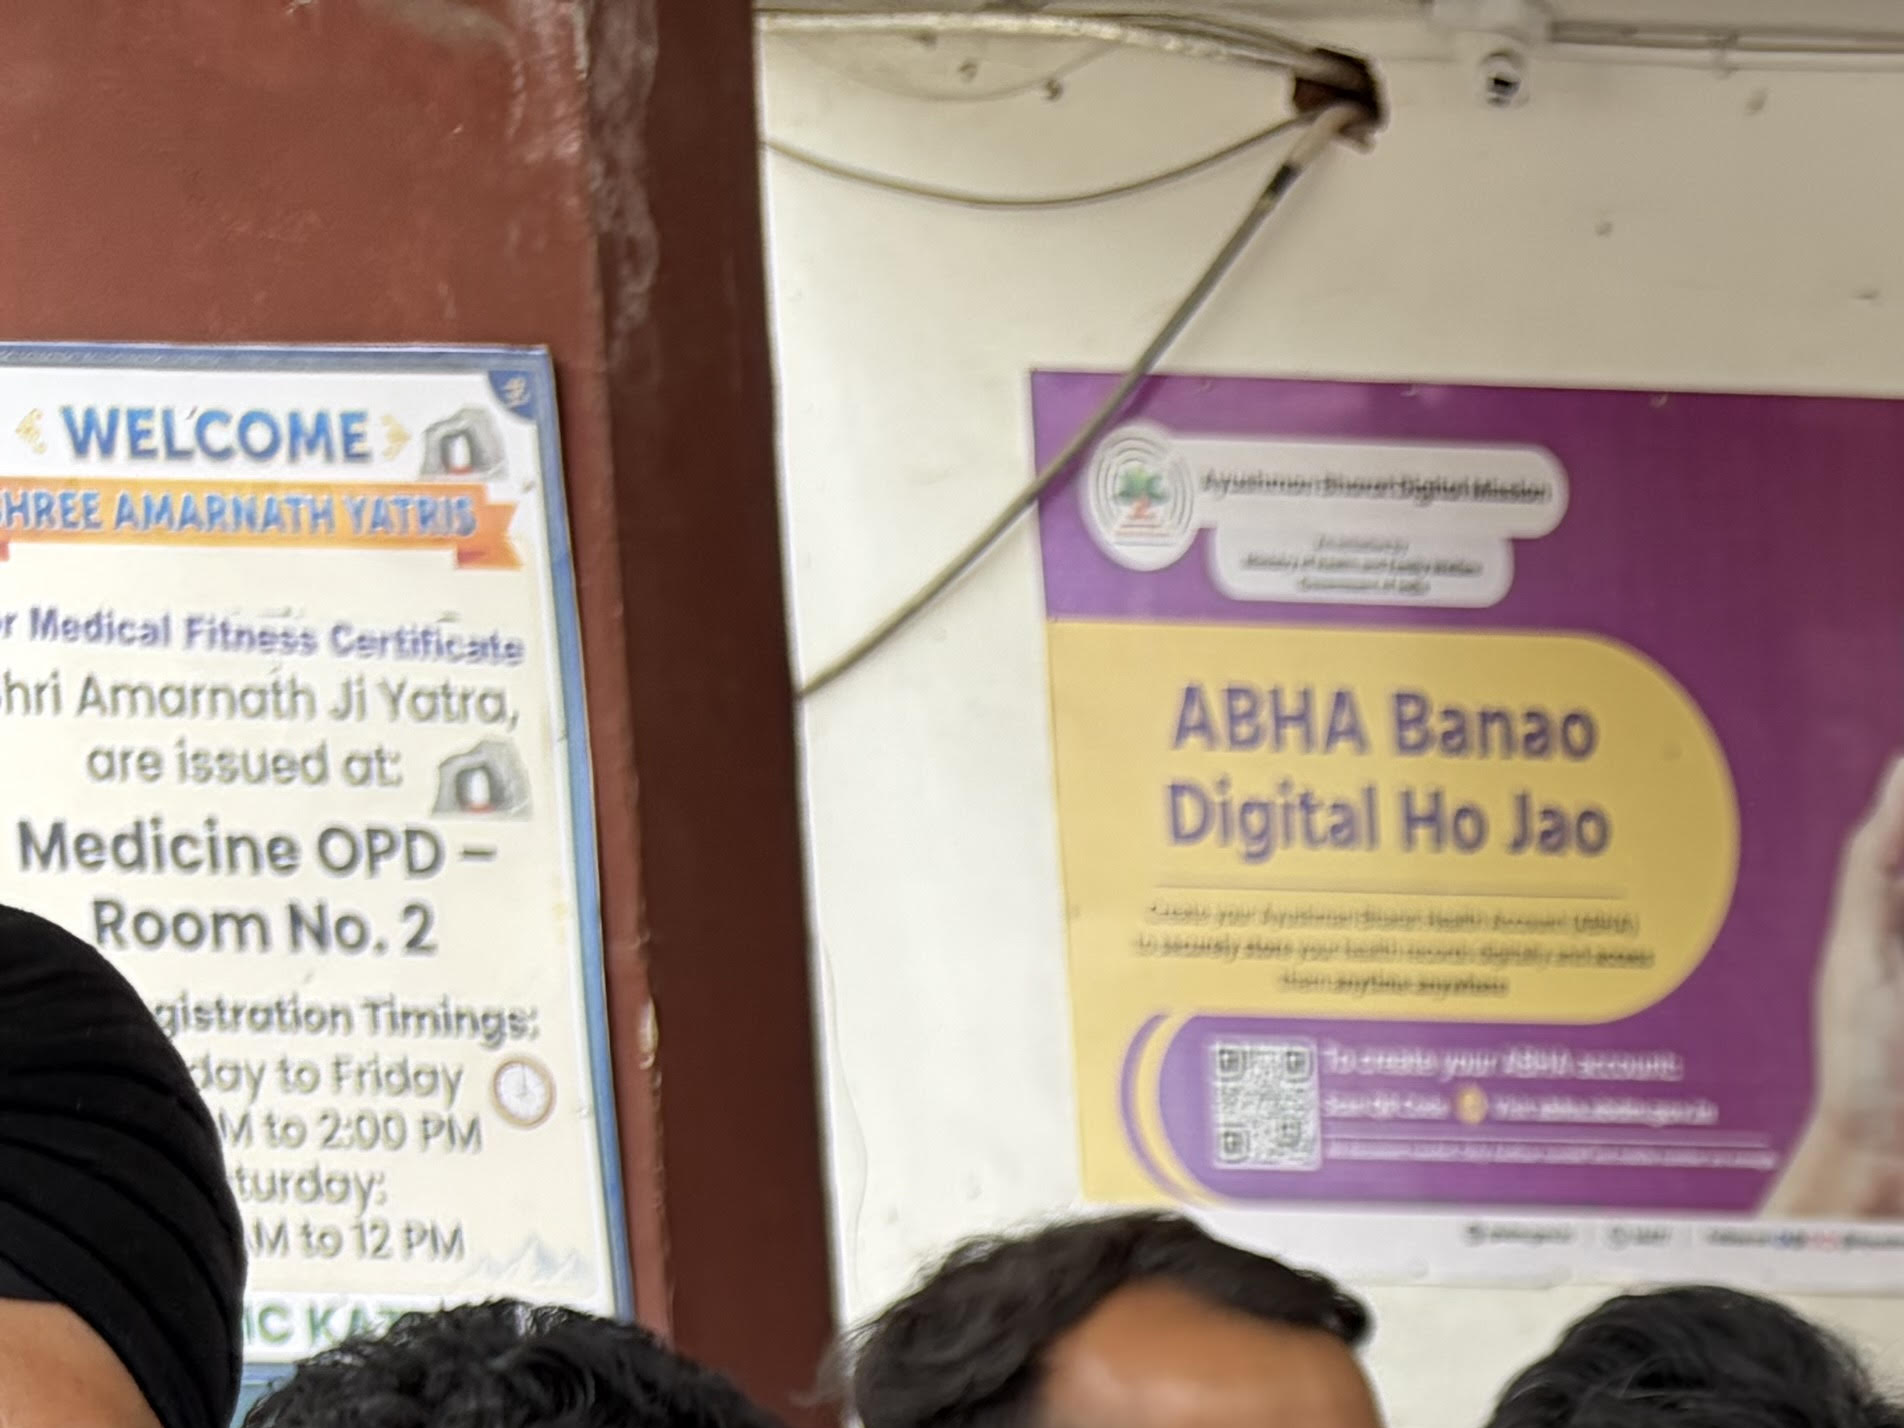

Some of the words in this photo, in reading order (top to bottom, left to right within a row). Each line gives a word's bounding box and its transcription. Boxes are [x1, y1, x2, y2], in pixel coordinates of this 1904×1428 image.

[60, 405, 374, 465] WELCOME
[0, 490, 104, 532] HREE
[113, 493, 336, 536] AMARNATH
[346, 497, 478, 539] YATRIS
[29, 605, 173, 649] Medical
[184, 614, 319, 656] Fitness
[330, 620, 527, 667] Certificate
[0, 670, 62, 718] hri
[76, 675, 317, 721] Amarnath
[330, 679, 366, 722] Ji
[379, 680, 520, 731] Yatra,
[1171, 683, 1369, 754] ABHA
[1391, 691, 1598, 763] Banao
[86, 748, 164, 785] are
[175, 739, 329, 788] issued
[18, 815, 302, 875] Medicine
[316, 825, 443, 879] OPD
[1165, 776, 1380, 864] Digital
[1401, 788, 1487, 855] Ho
[1506, 789, 1612, 857] Jao
[93, 899, 272, 954] Room
[287, 902, 389, 958] No.
[401, 905, 439, 956] 2
[153, 994, 354, 1044] gistration
[189, 1056, 269, 1106] day
[278, 1060, 321, 1095] to
[332, 1060, 464, 1111] Friday
[264, 1112, 309, 1150] to
[319, 1112, 409, 1152] 2:00
[419, 1115, 482, 1154] PM
[234, 1165, 388, 1216] turday:
[303, 1223, 345, 1260] to
[355, 1224, 394, 1260] 12
[403, 1226, 466, 1263] PM
